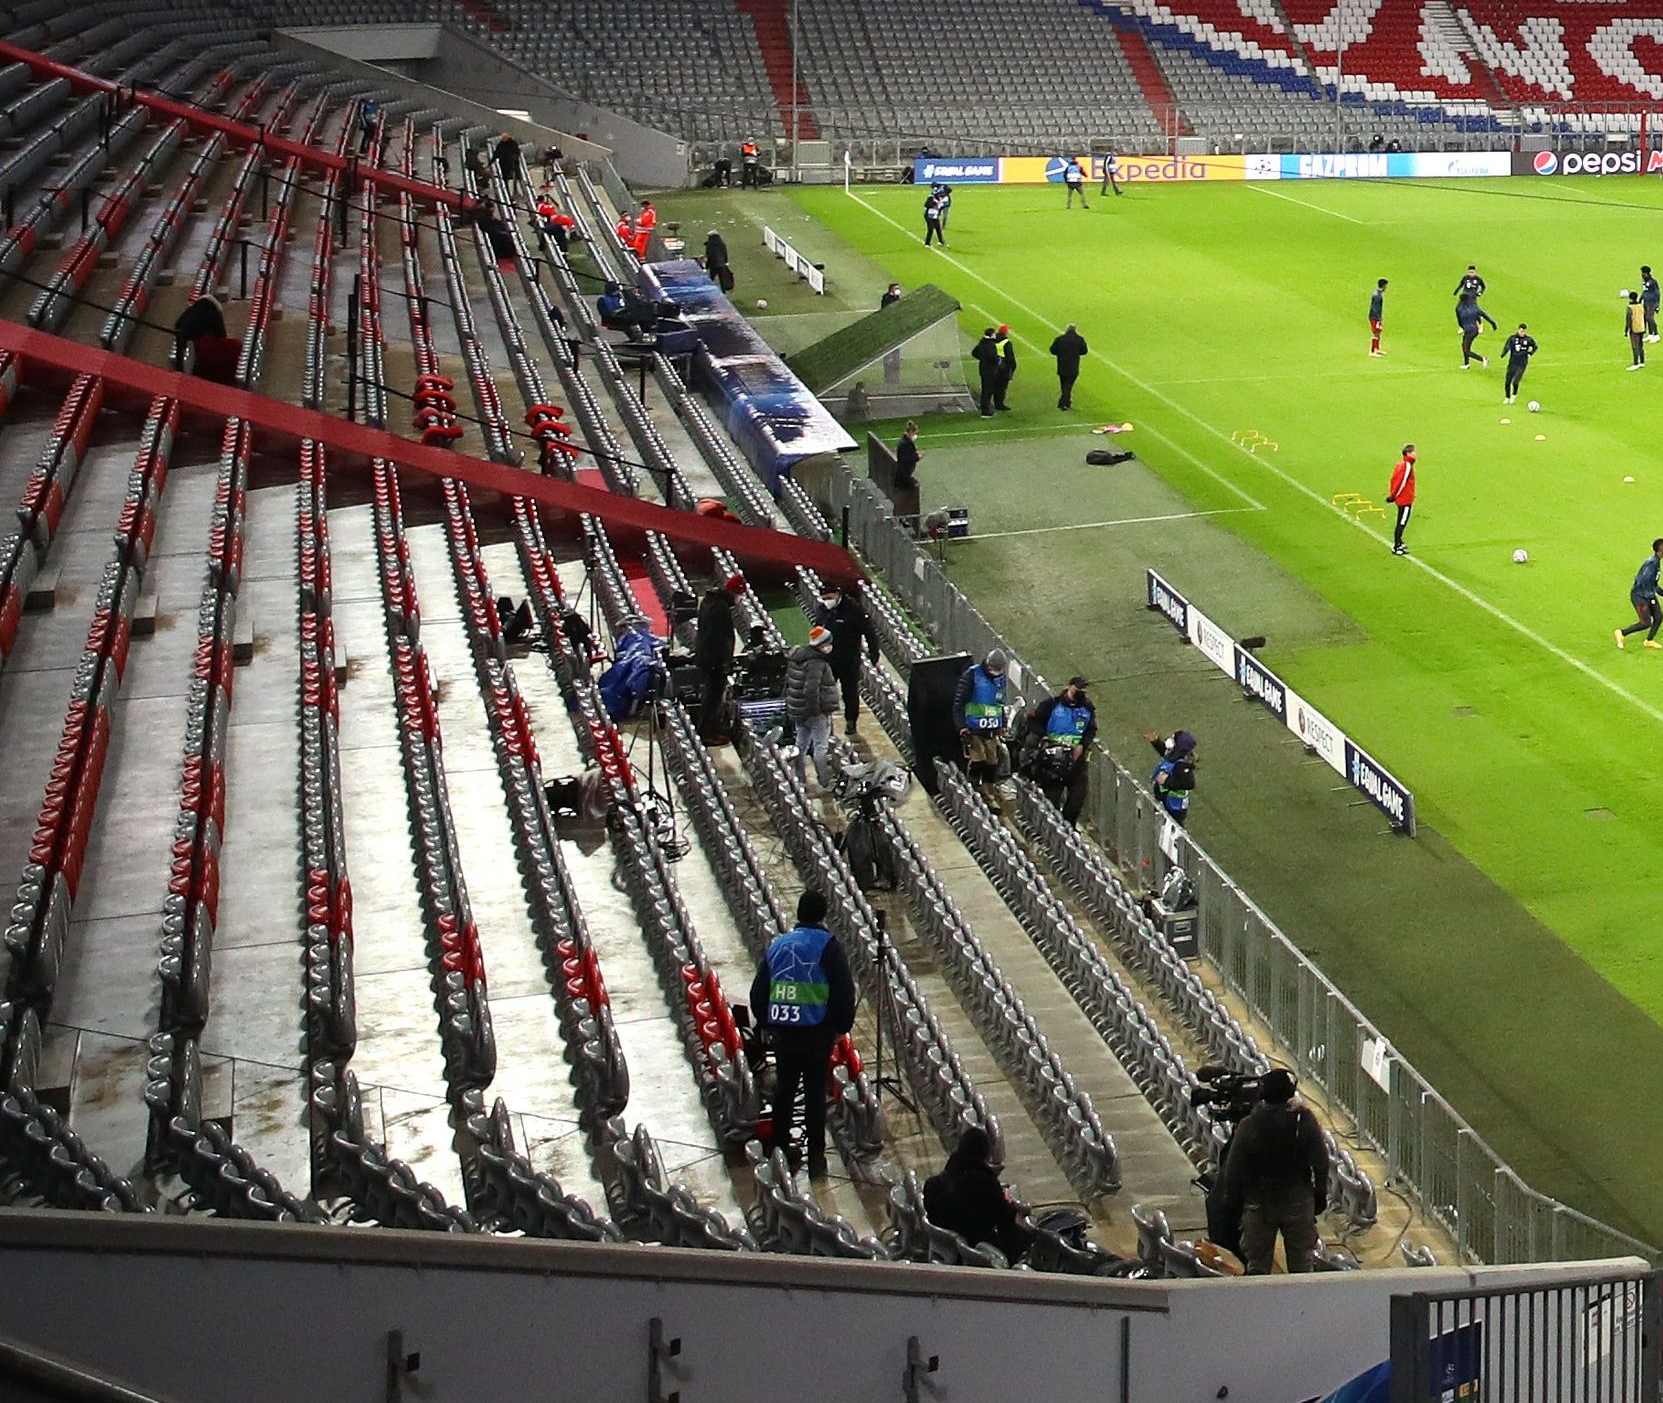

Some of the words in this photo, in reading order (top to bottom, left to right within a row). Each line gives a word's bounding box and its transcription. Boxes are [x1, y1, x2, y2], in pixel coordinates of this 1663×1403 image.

[1299, 153, 1388, 178] GAZPROM
[1563, 150, 1643, 174] pepsi
[775, 984, 798, 999] HB
[770, 1005, 801, 1023] 033
